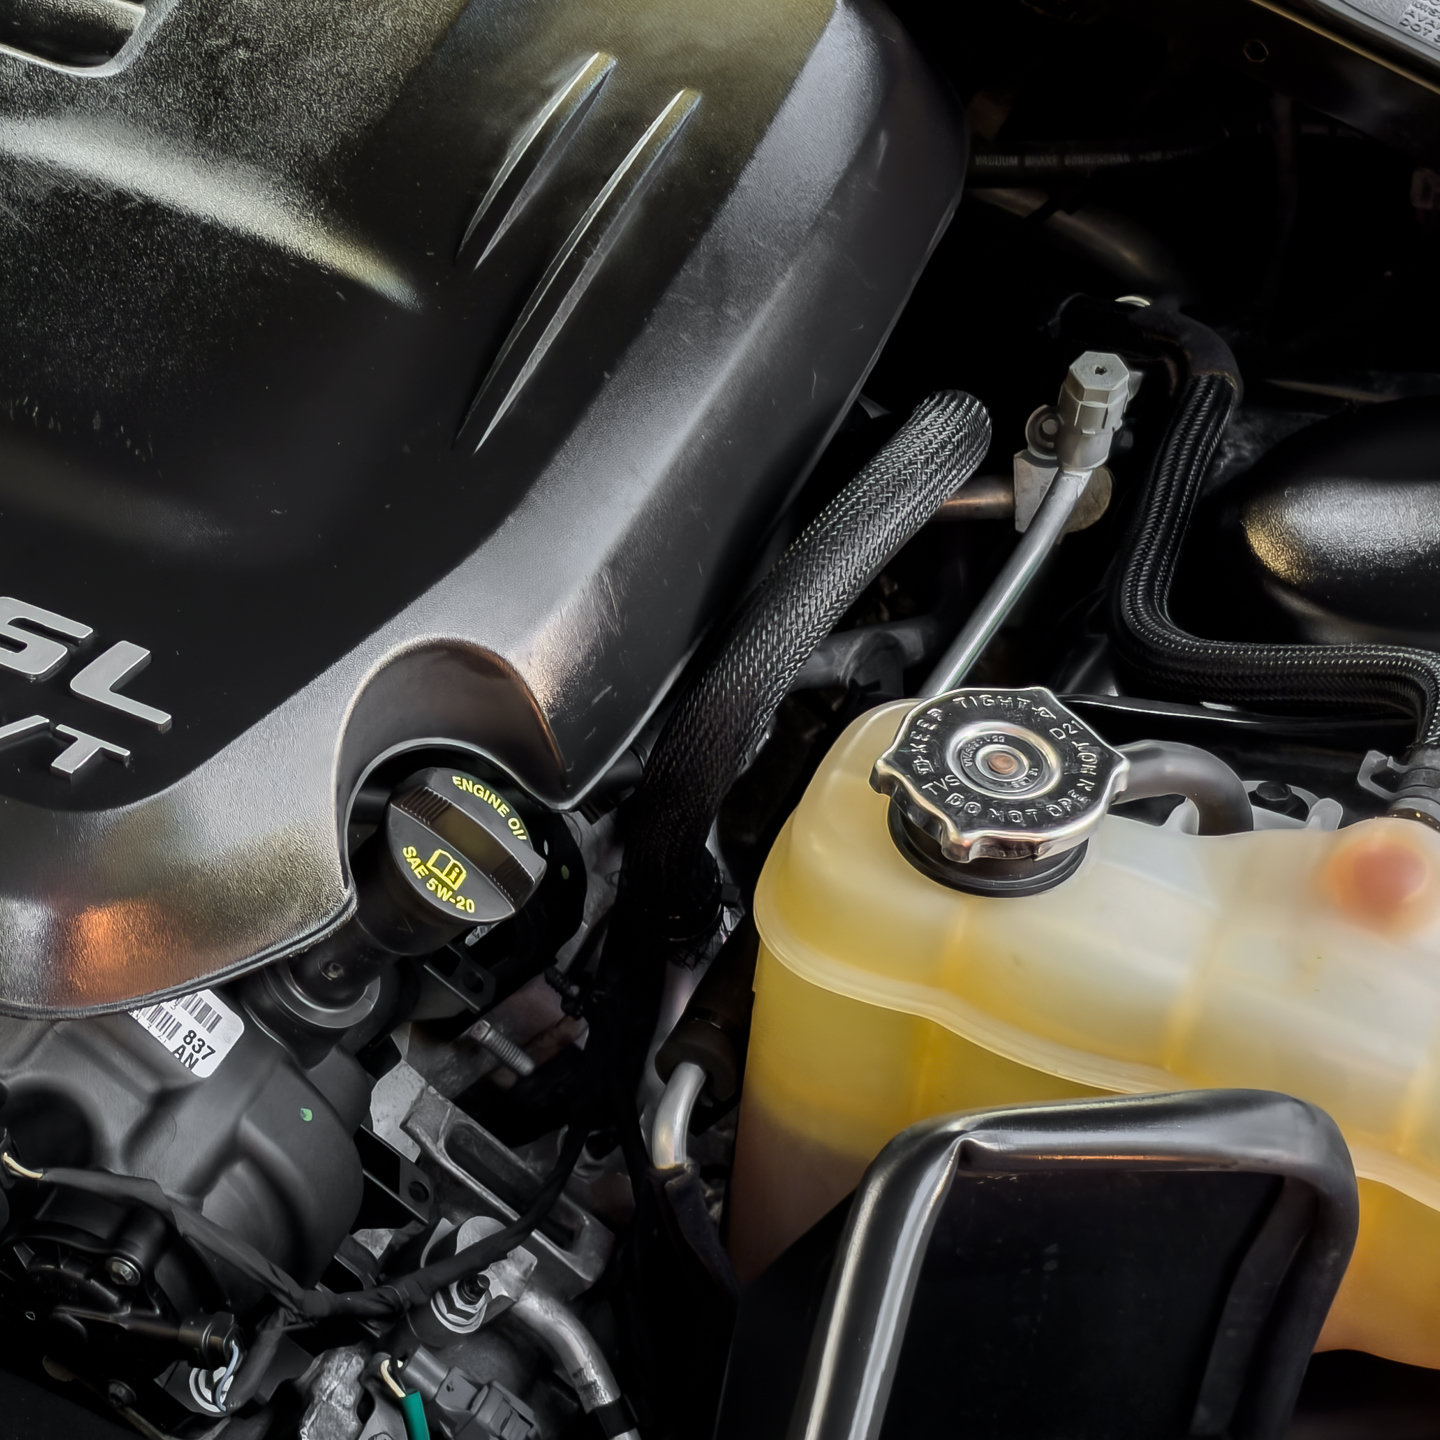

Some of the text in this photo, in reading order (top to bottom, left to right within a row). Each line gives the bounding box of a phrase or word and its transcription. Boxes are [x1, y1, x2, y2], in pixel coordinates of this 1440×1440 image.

[1399, 18, 1433, 37] DOT
[953, 695, 1031, 712] TIGHT
[452, 775, 510, 818] ENGINE
[922, 774, 961, 796] TVS
[945, 792, 982, 815] DO
[991, 807, 1039, 824] NOT
[402, 846, 475, 913] SAE 5W-20
[173, 1045, 199, 1070] AN
[183, 1030, 216, 1061] 837
